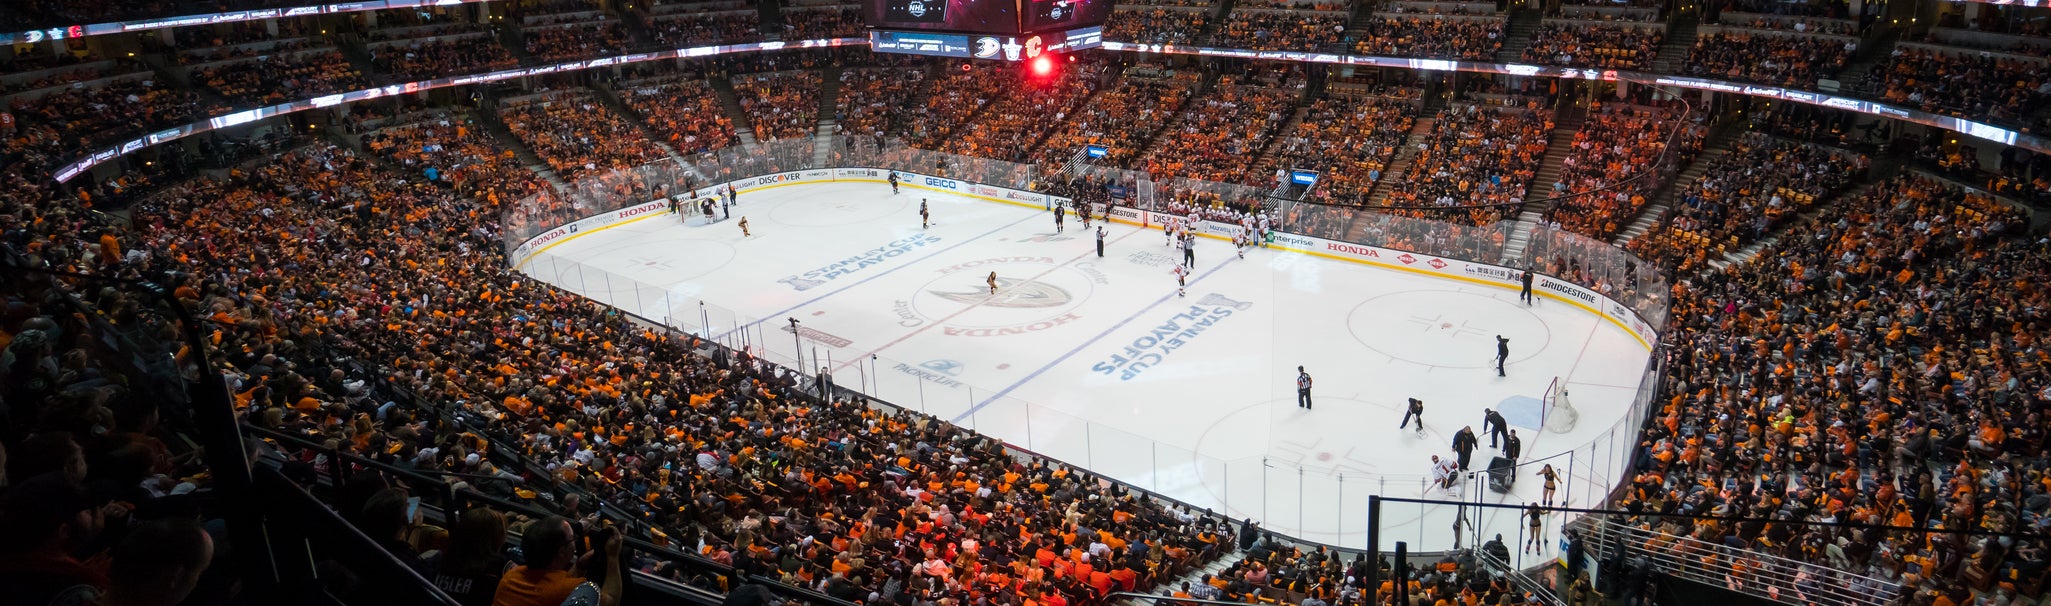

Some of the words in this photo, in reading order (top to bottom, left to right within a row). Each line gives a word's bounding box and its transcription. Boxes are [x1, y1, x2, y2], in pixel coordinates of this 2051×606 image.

[908, 4, 926, 12] NHL
[739, 180, 756, 189] LIGHT
[759, 173, 801, 186] DISCOVER
[925, 176, 957, 190] GEICO
[619, 202, 665, 219] HONDA
[530, 228, 566, 250] HONDA
[803, 246, 885, 279] STANLEY
[888, 233, 925, 248] CUP
[823, 235, 942, 280] PLAYOFFS
[1327, 242, 1379, 258] HONDA
[936, 255, 1054, 275] HONDA
[1540, 279, 1596, 304] BRIDGESTONE
[943, 312, 1083, 337] HONDA
[1159, 306, 1233, 355] STANLEY
[1091, 305, 1208, 375] PLAYOFFS
[893, 362, 937, 381] PACIFIC
[1120, 352, 1163, 381] CUP
